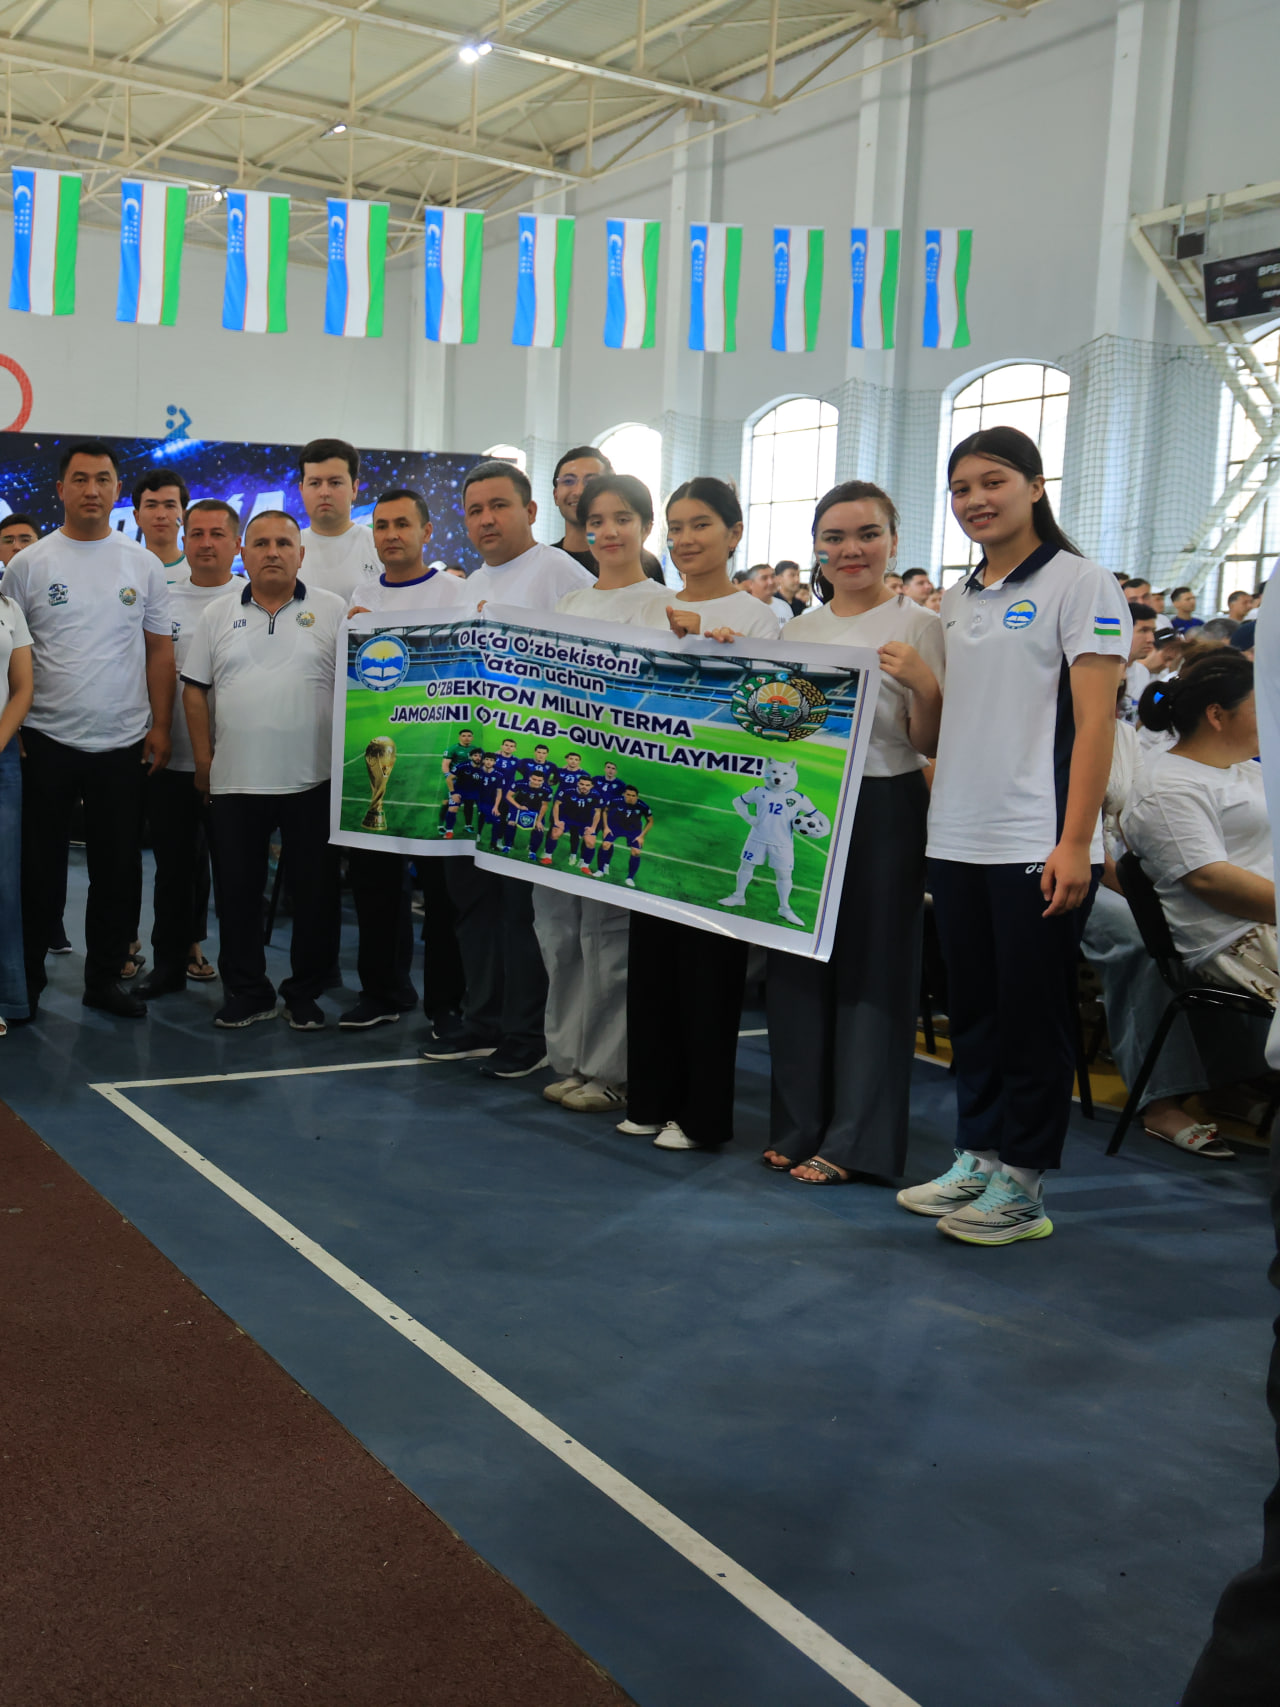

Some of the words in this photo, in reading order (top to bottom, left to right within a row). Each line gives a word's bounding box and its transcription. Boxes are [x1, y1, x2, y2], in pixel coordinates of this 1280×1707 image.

[233, 618, 247, 629] UZB
[545, 669, 605, 693] uchun
[390, 705, 469, 722] JAMOASINI
[542, 693, 604, 721] MILLIY
[610, 708, 692, 738] TERMA
[768, 803, 784, 816] 12
